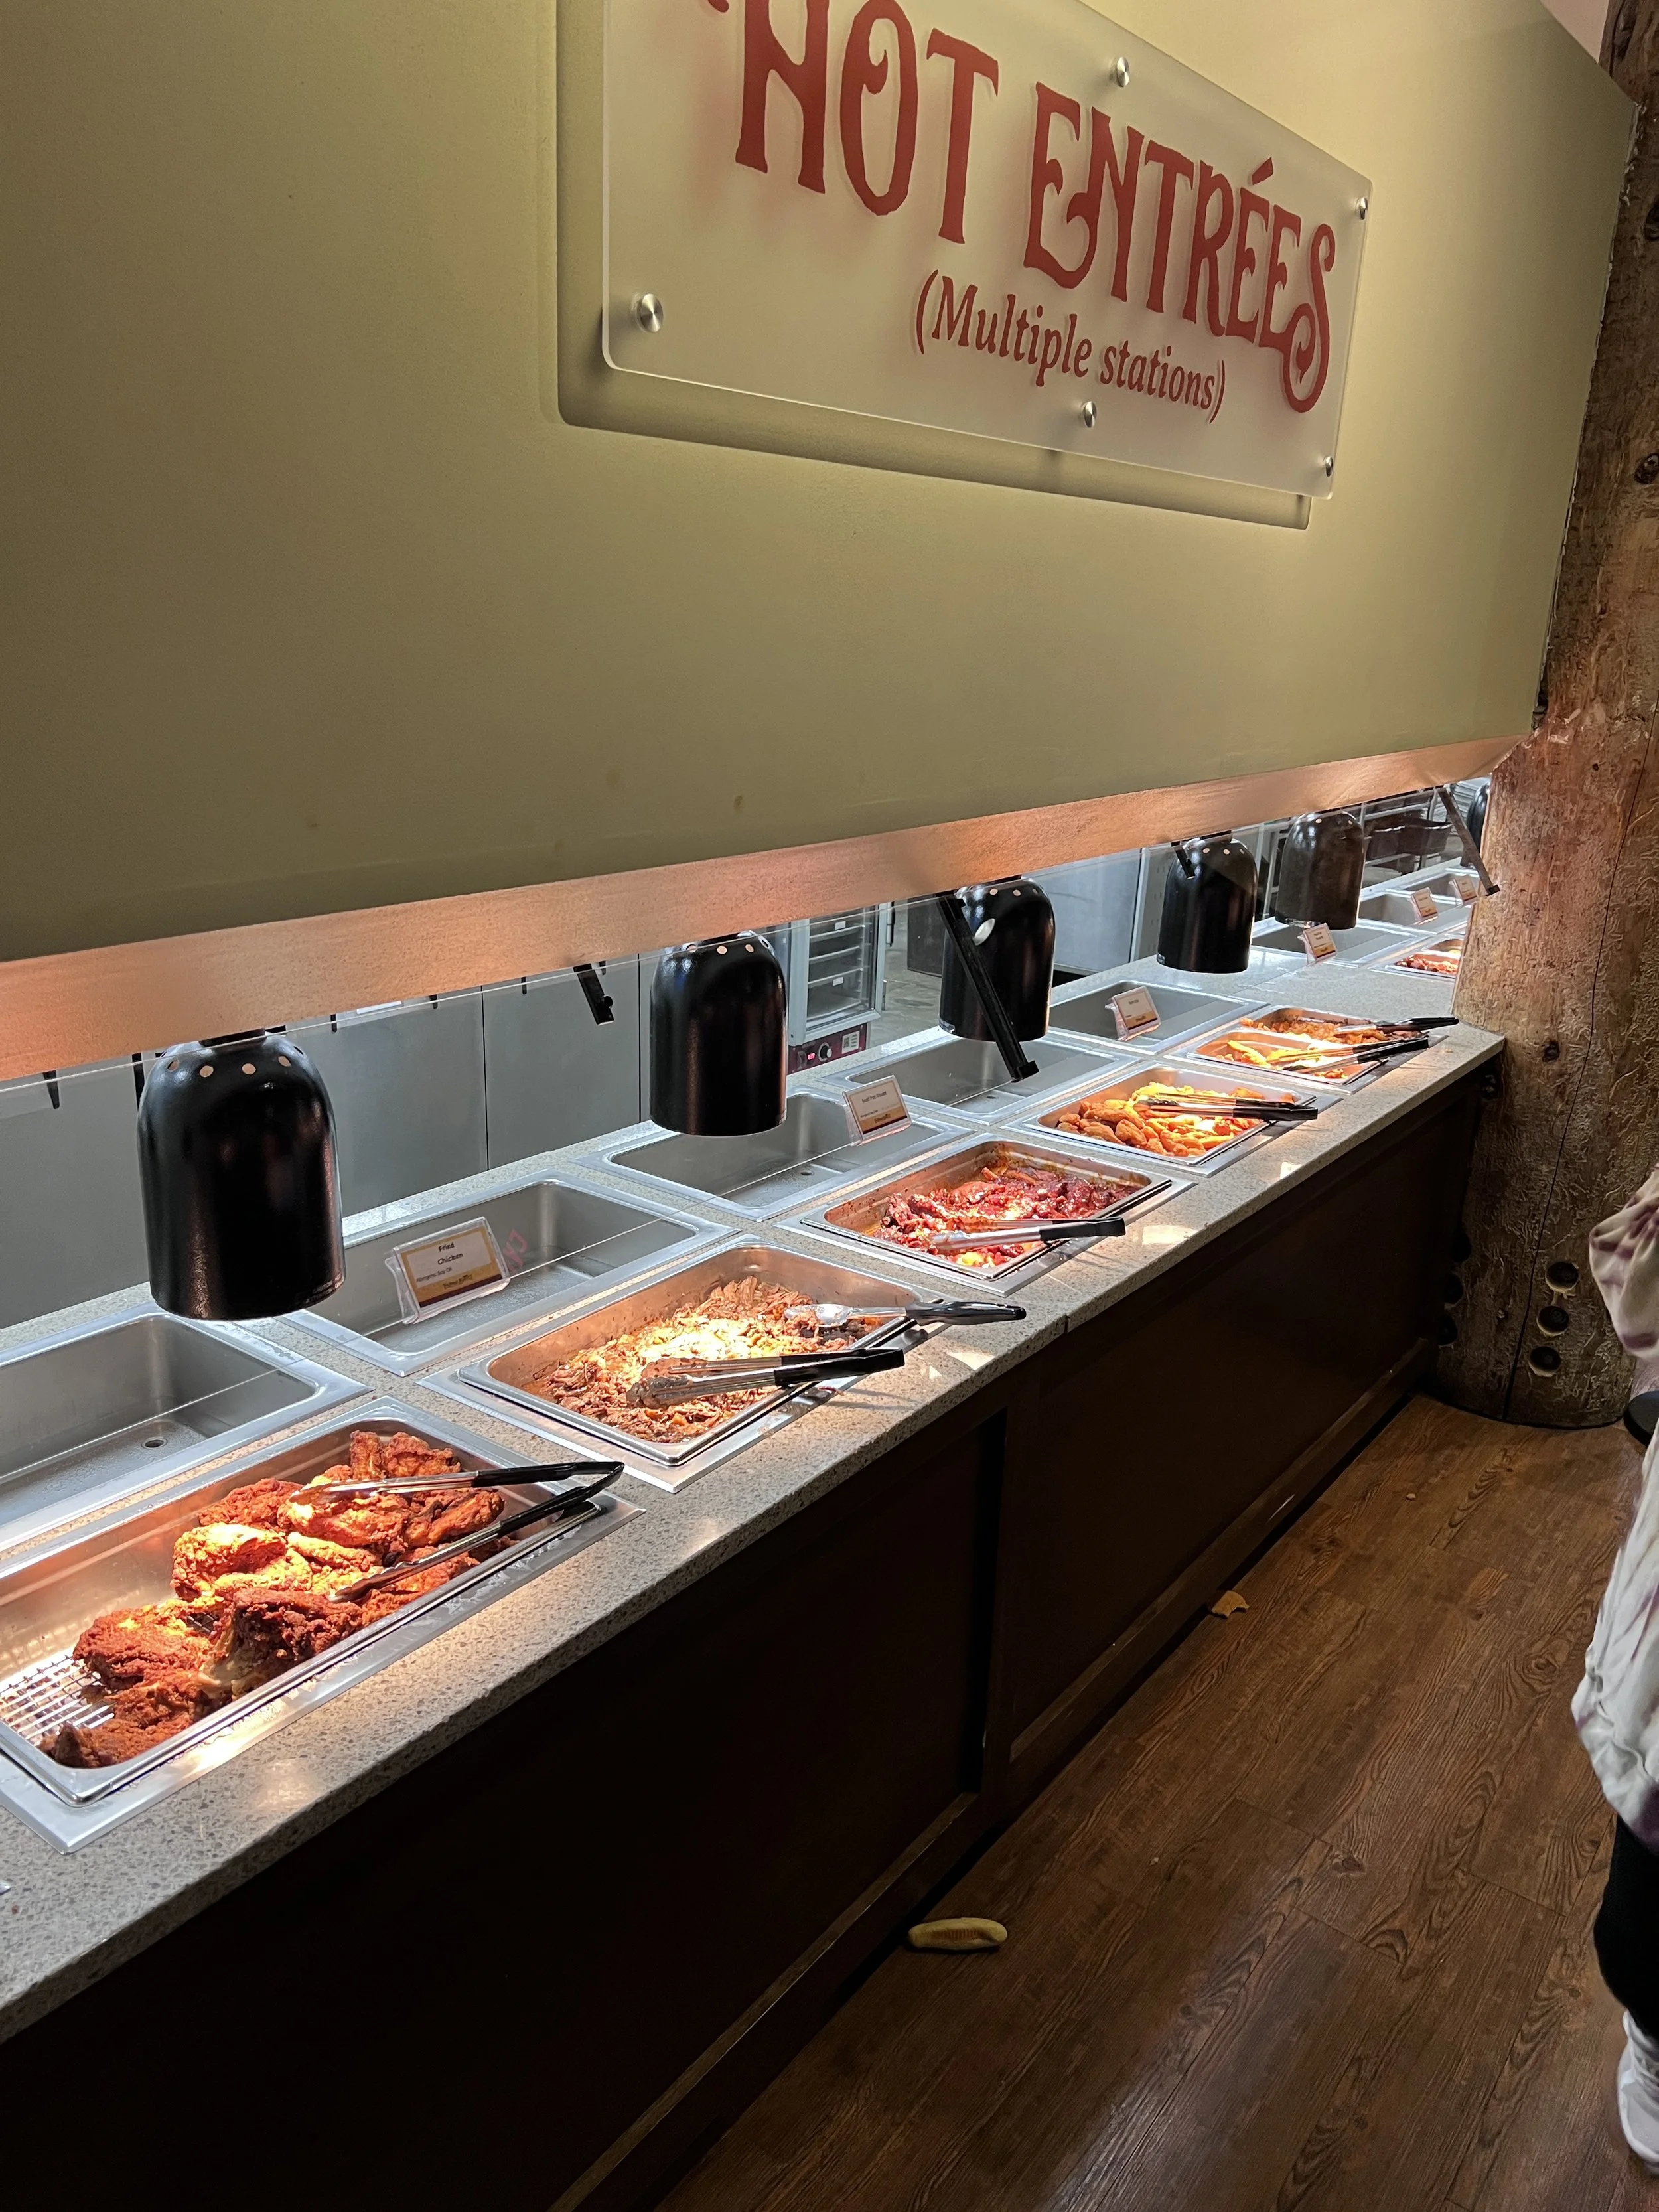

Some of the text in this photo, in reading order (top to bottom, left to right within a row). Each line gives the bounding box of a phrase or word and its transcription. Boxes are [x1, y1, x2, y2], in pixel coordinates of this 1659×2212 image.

[707, 0, 1335, 413] HOT ENTRÉES
[916, 269, 1226, 424] (Multiple stations)
[437, 1252, 464, 1265] Chicken
[438, 1241, 455, 1252] Fried
